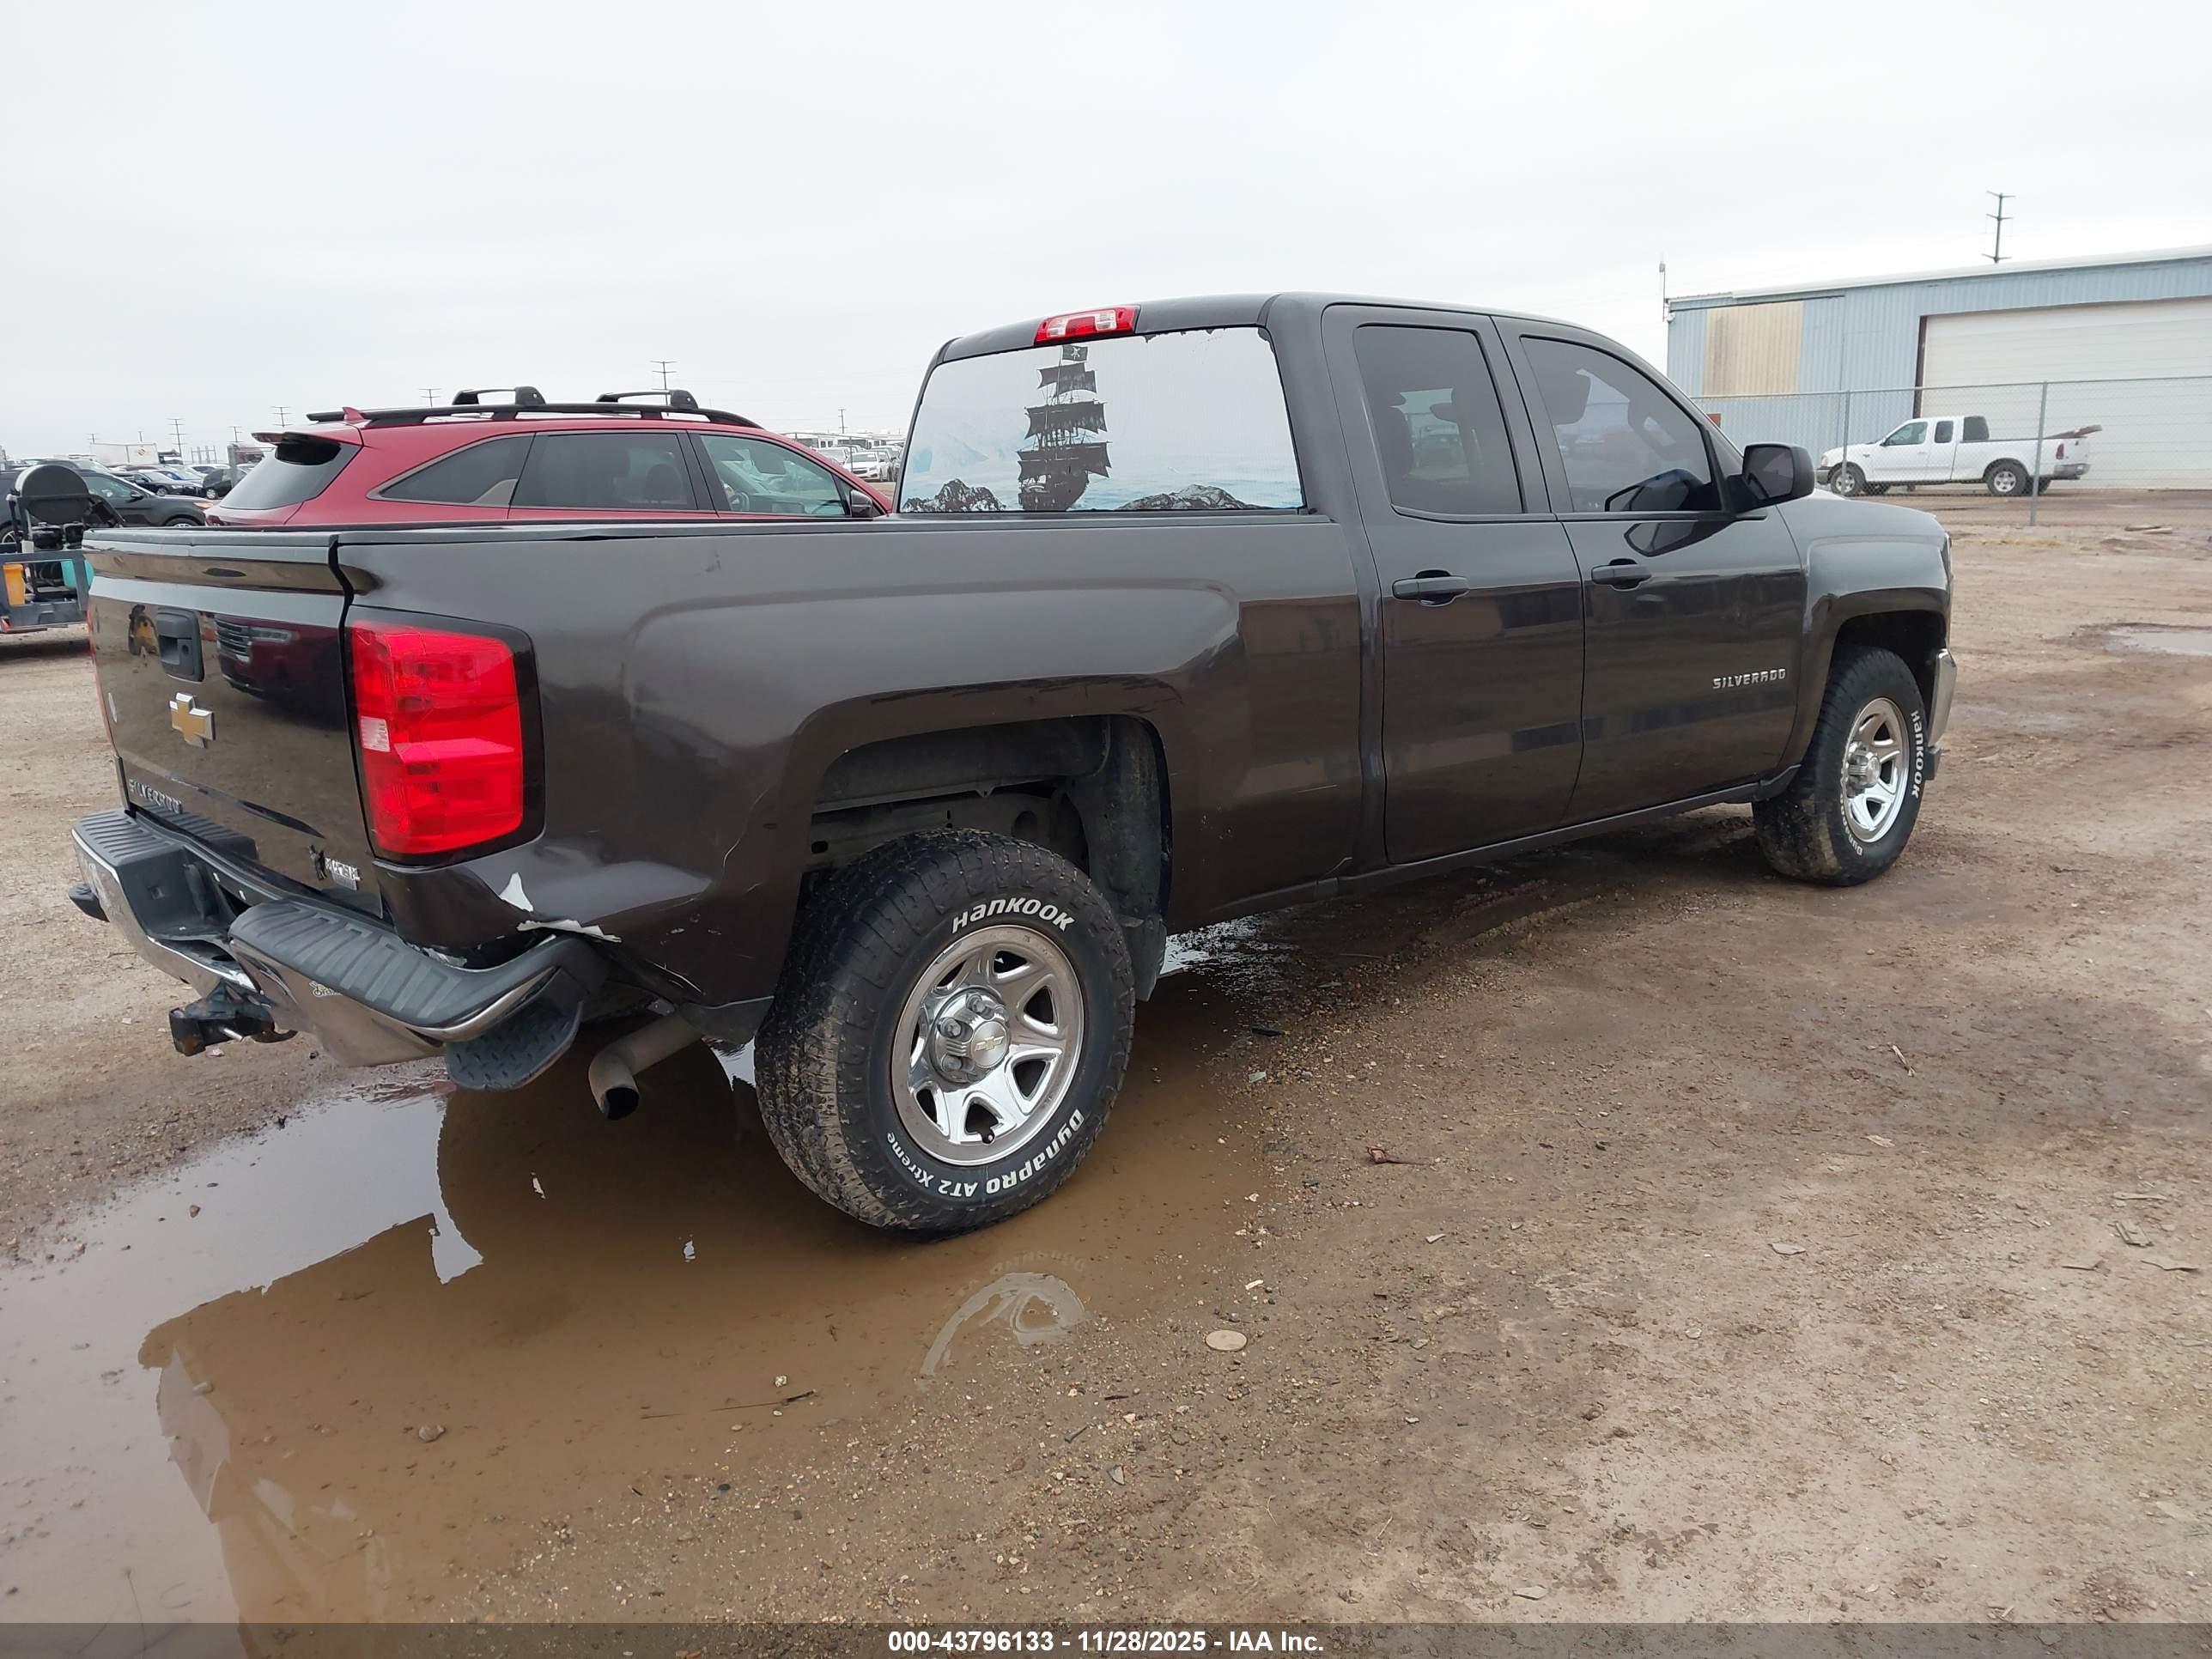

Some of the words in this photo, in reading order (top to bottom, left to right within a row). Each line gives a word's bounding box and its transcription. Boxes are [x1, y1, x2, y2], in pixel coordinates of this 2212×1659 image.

[1712, 668, 1786, 689] SILVERADO
[951, 897, 1075, 934] HanKOOK
[885, 1132, 933, 1188] Xtreme
[938, 1178, 979, 1198] AT2
